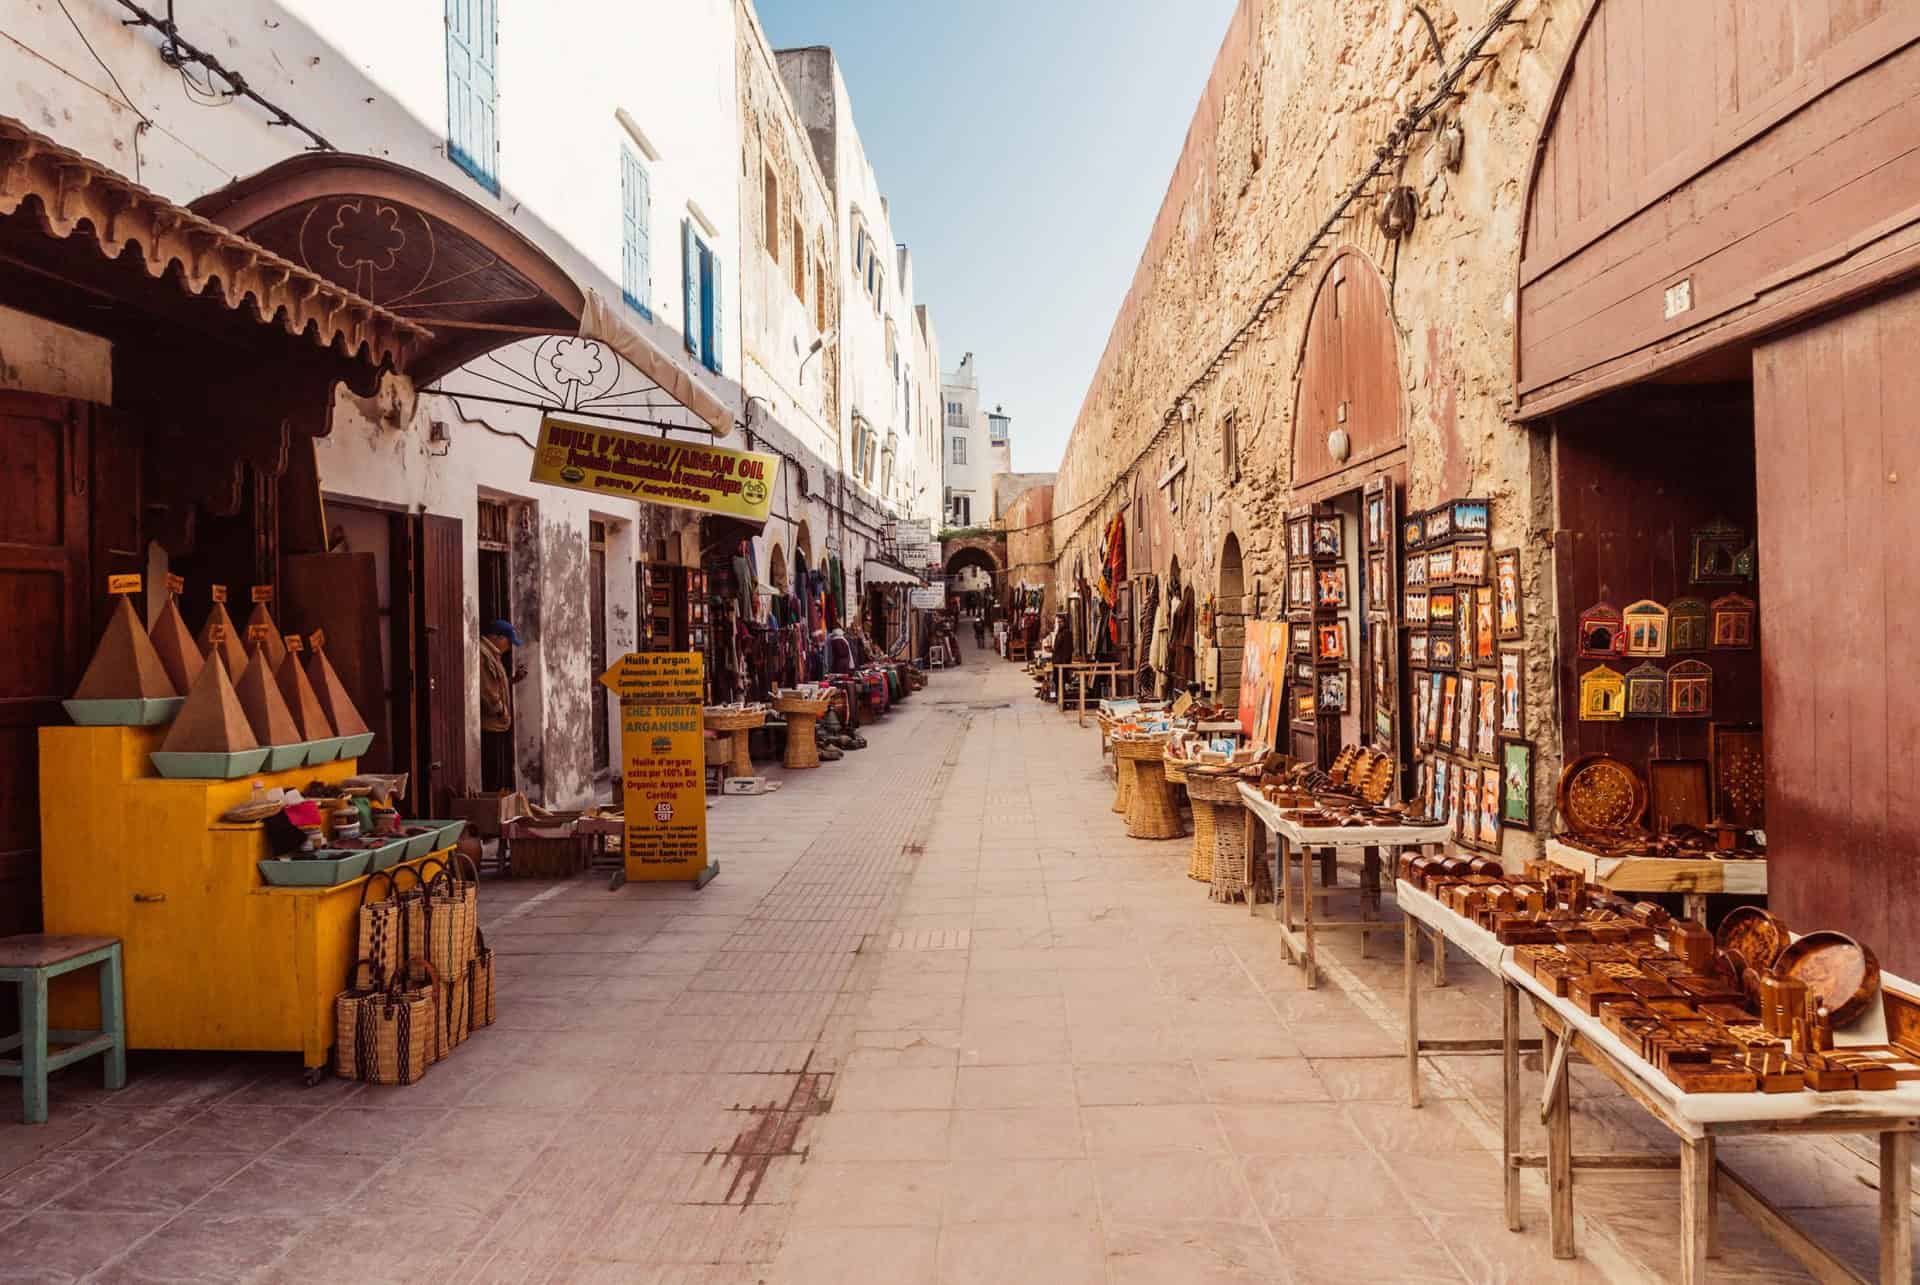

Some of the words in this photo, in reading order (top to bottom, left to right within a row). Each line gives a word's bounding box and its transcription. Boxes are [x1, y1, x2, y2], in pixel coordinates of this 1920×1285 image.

[548, 425, 595, 451] HUILE
[738, 458, 764, 480] OIL
[625, 656, 650, 665] Huile
[653, 655, 690, 666] d'argan
[625, 706, 651, 717] CHEZ
[625, 720, 697, 733] ARGANISME
[657, 803, 672, 811] ECO
